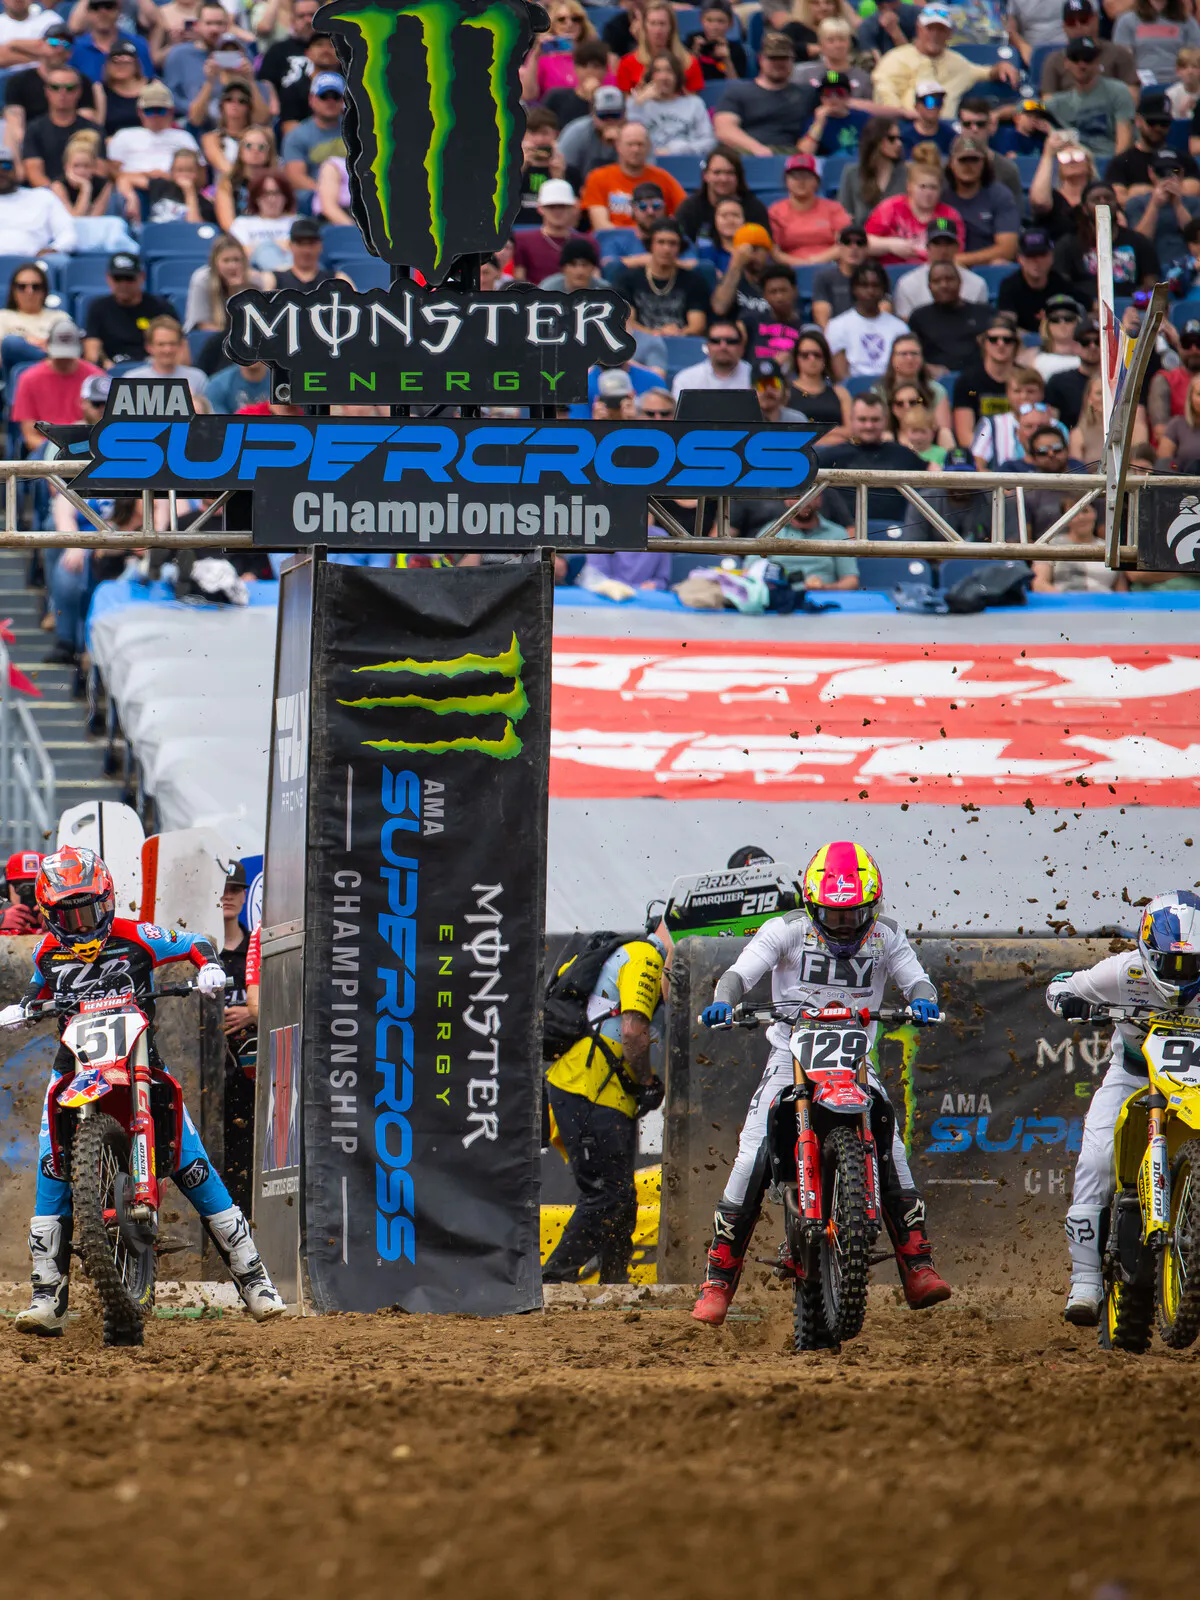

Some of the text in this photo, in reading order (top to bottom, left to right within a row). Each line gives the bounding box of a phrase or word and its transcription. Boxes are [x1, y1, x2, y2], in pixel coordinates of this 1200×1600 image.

[242, 291, 625, 357] MONSTER
[112, 384, 191, 416] AMA
[304, 371, 567, 392] ENERGY
[87, 421, 818, 488] SUPERCROSS
[292, 491, 611, 545] Championship
[423, 778, 445, 836] AMA
[692, 890, 780, 916] MARQUIER 219
[695, 870, 749, 892] PRMX
[802, 951, 873, 987] FLY
[84, 998, 127, 1011] RENTHAL
[330, 870, 362, 1154] CHAMPIONSHIP
[374, 764, 421, 1265] SUPERCROSS
[436, 924, 454, 1106] ENERGY
[461, 881, 510, 1149] MONSTER
[76, 1016, 127, 1061] 51
[797, 1031, 868, 1070] 129
[940, 1093, 993, 1114] AMA
